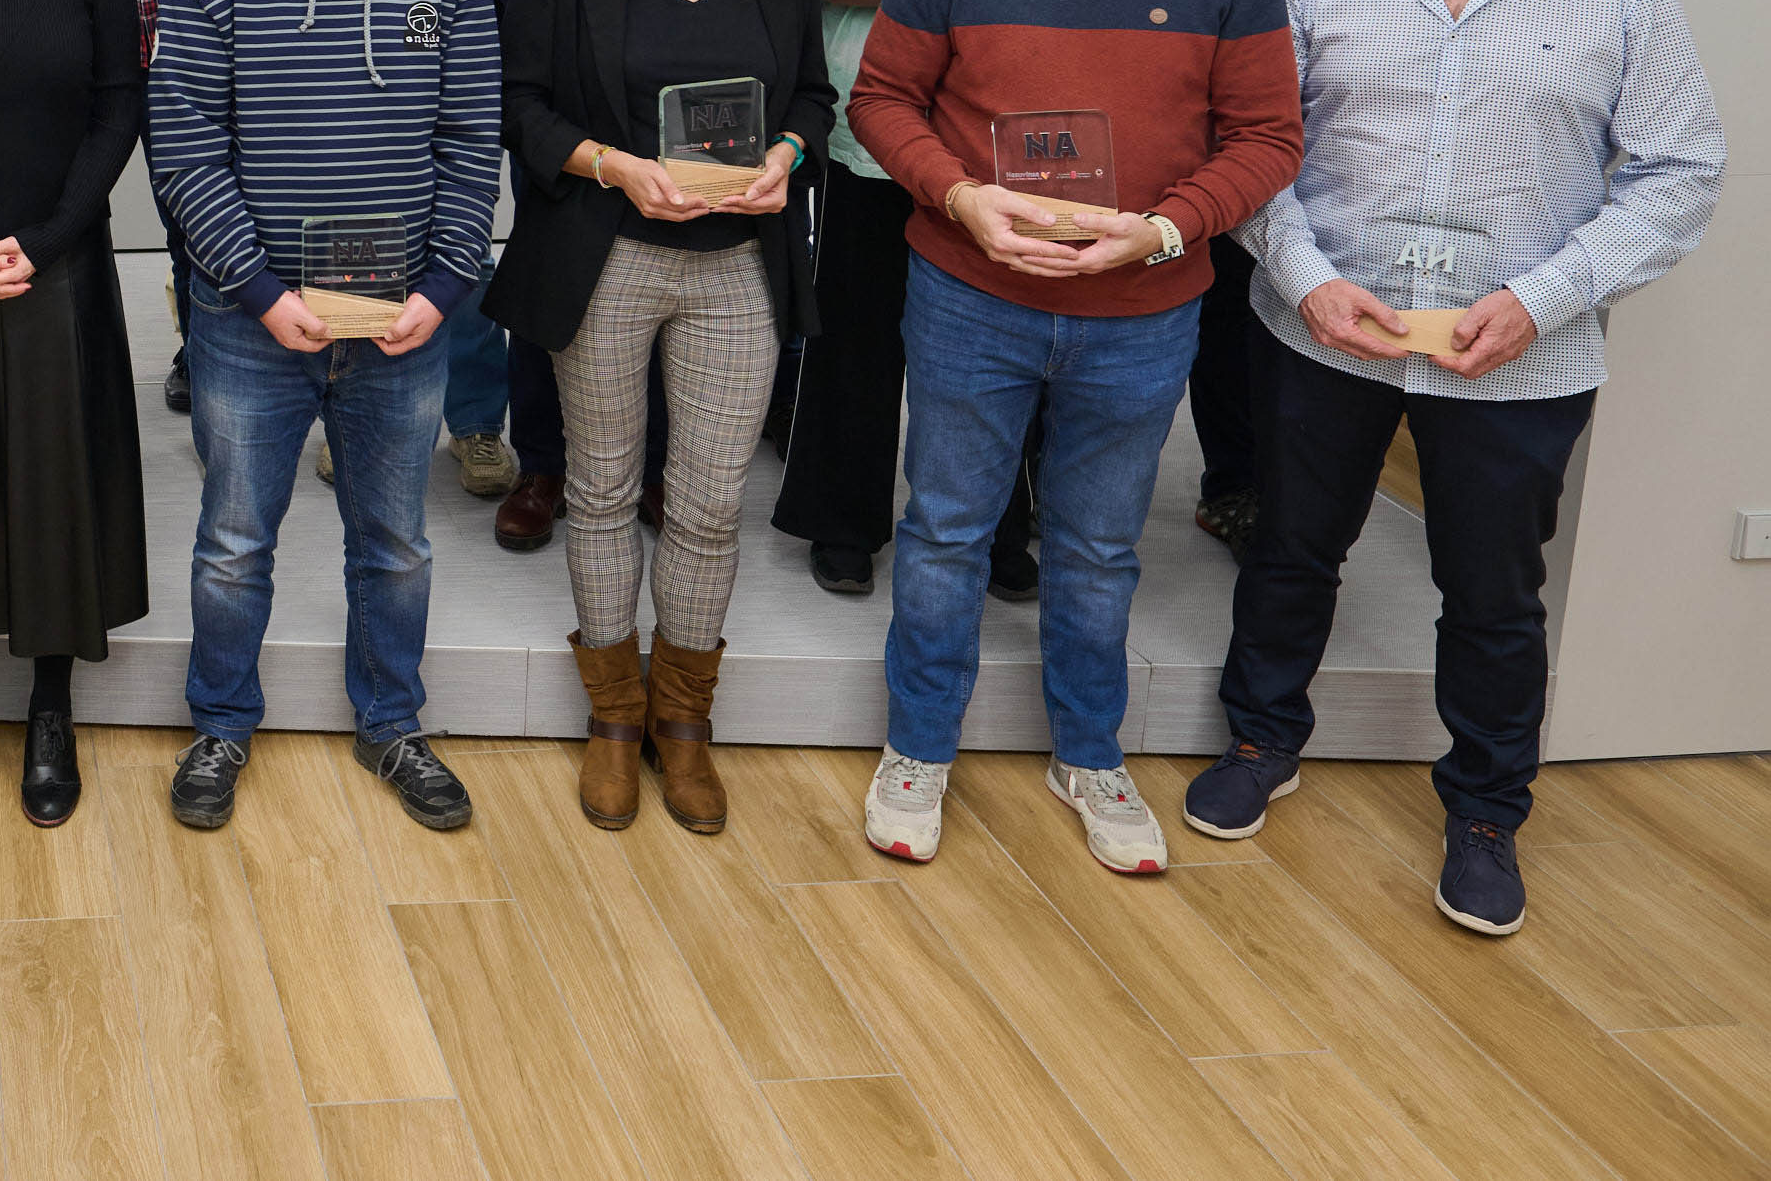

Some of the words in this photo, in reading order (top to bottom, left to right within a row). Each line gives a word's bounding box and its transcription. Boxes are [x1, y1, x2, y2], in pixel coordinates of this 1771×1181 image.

[690, 103, 738, 131] NA
[1024, 131, 1081, 159] NA
[331, 238, 378, 263] NA
